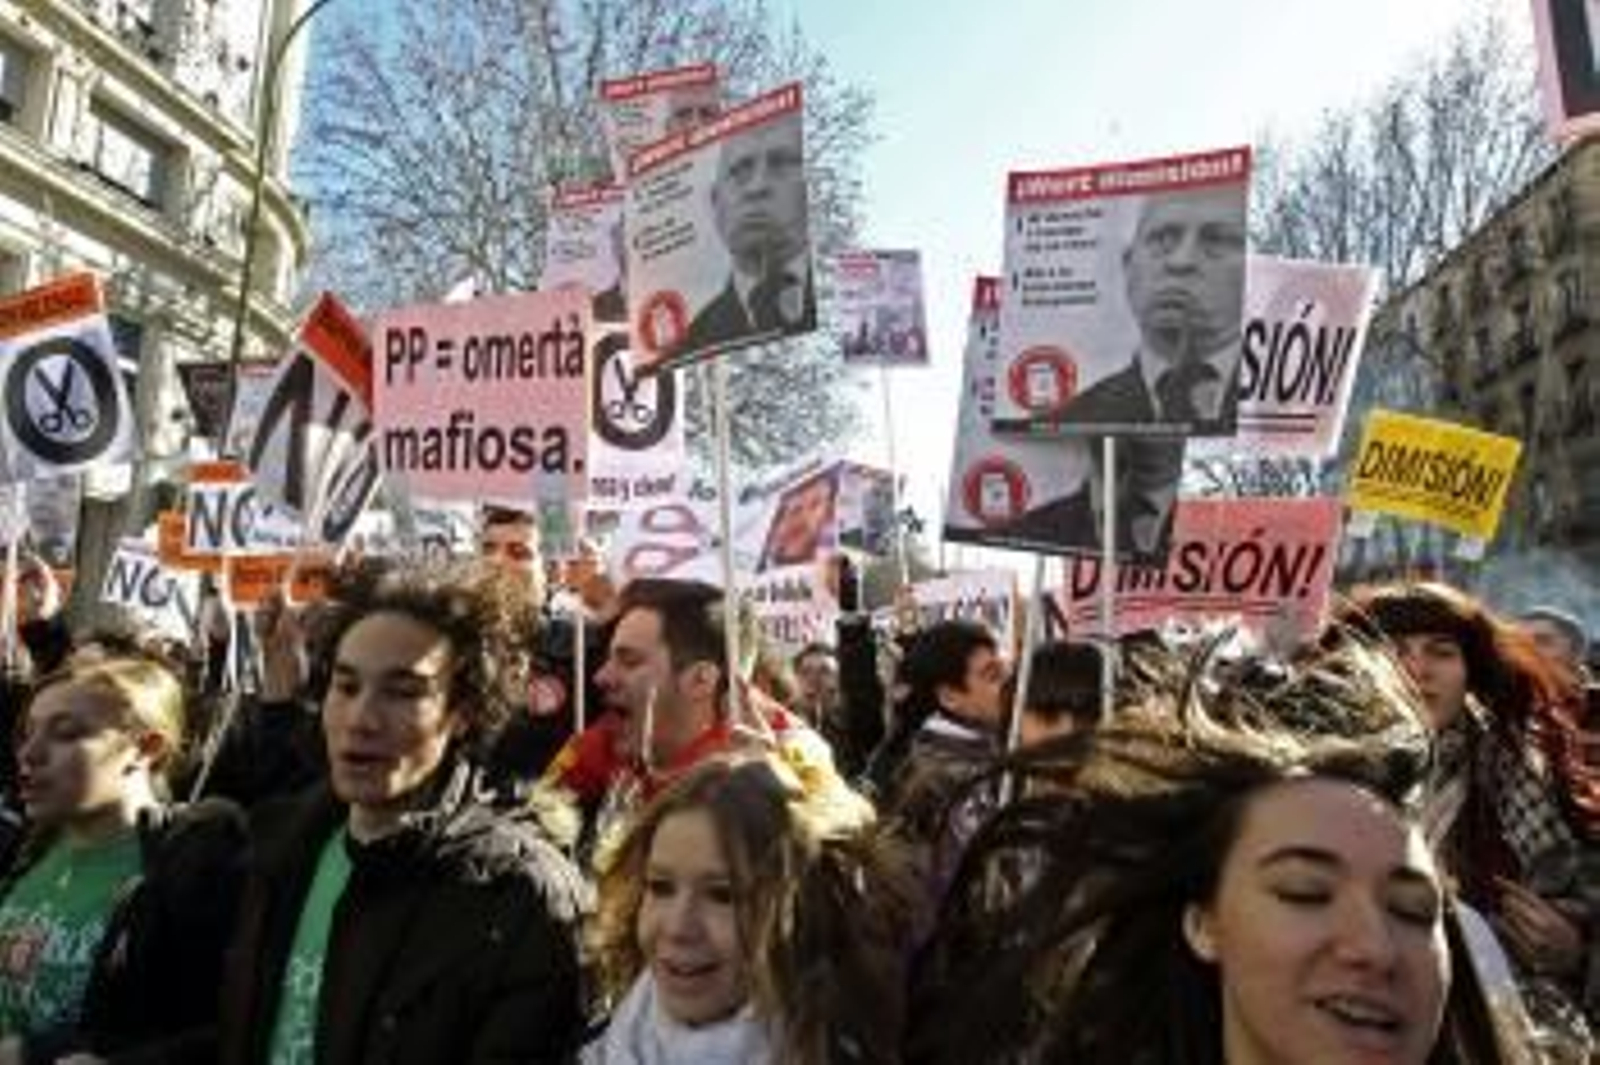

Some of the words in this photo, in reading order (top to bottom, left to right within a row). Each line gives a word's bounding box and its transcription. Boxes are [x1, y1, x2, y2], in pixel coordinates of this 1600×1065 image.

[386, 326, 427, 386] PP
[435, 336, 453, 370] =
[463, 313, 585, 382] omertà
[385, 411, 585, 475] mafiosa.
[1359, 440, 1503, 511] DIMISIÓN!
[1071, 528, 1325, 600] DMISIÓN!
